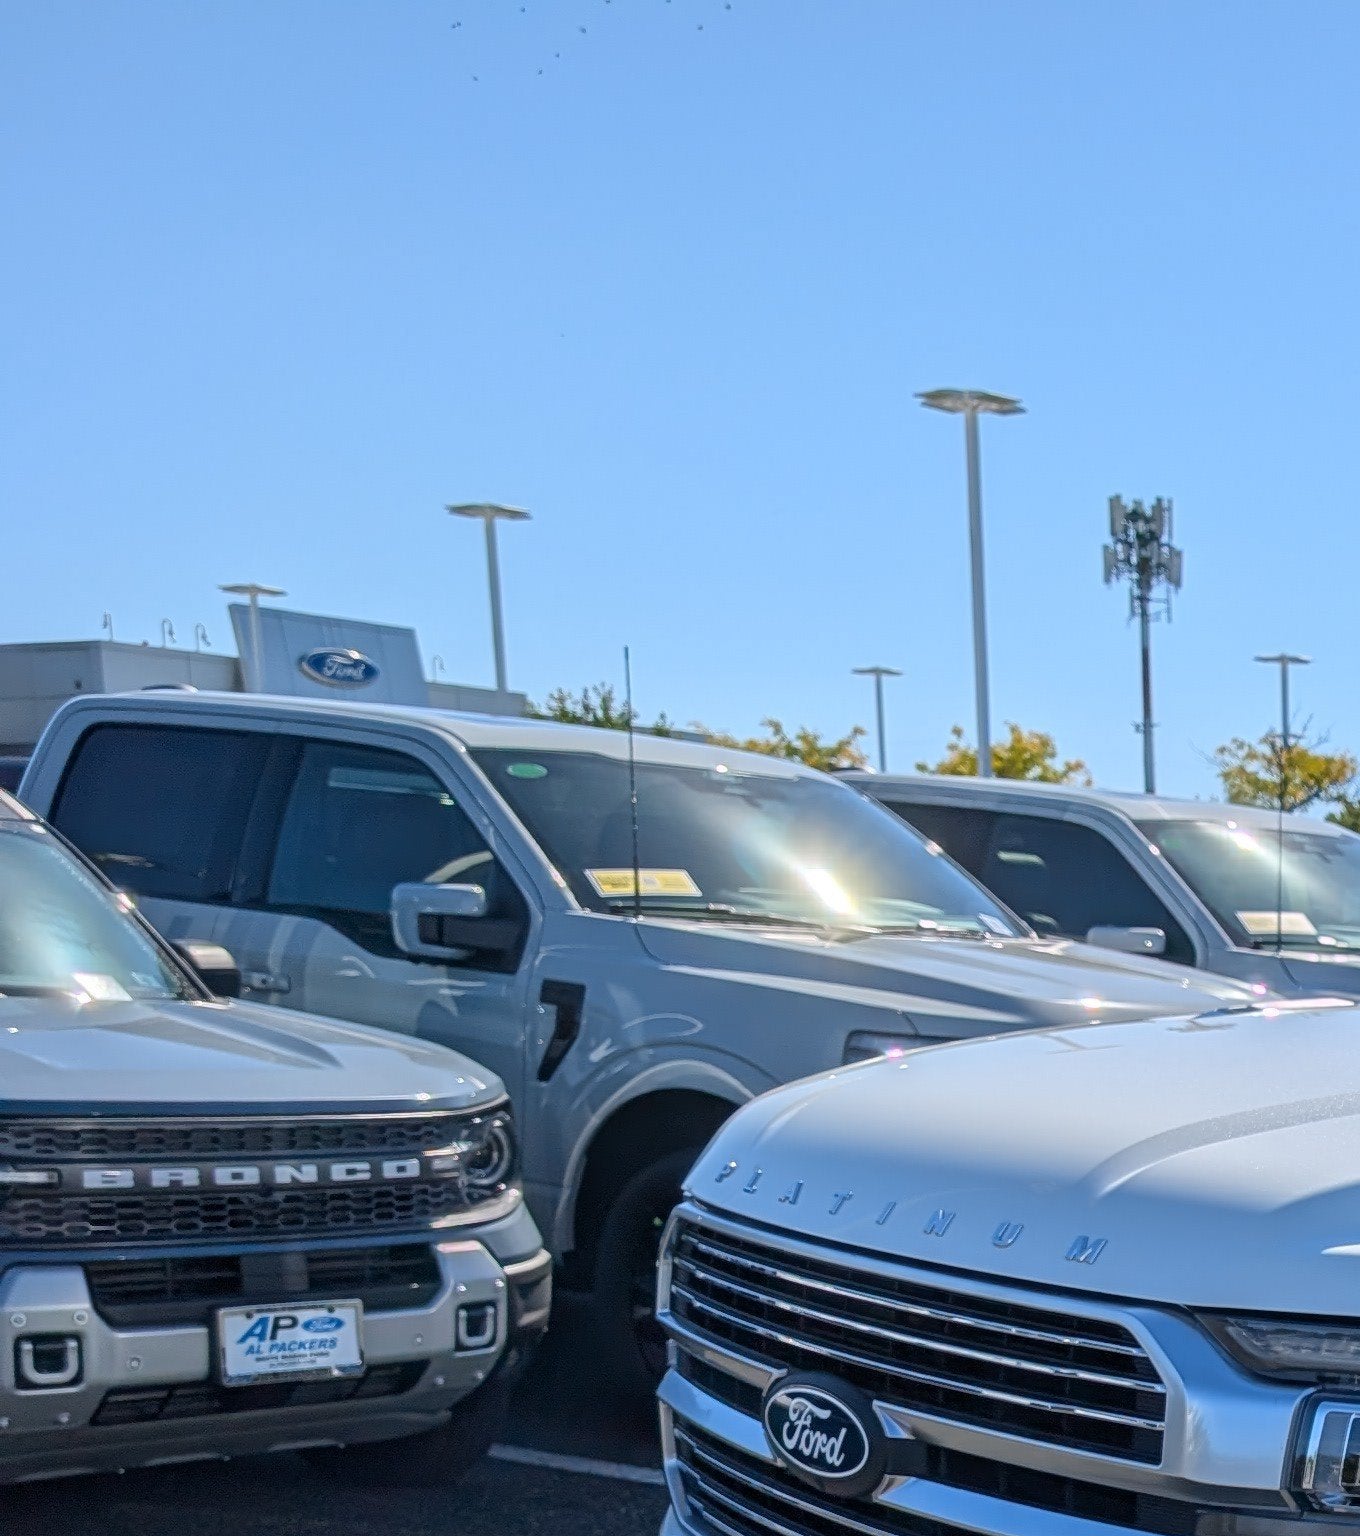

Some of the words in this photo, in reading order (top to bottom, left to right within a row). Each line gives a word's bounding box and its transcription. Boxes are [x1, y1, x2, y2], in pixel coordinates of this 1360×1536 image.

[322, 654, 366, 680] Ford
[82, 1157, 421, 1189] BRONCO
[714, 1160, 1109, 1265] PLATINUM
[237, 1315, 299, 1345] AP
[245, 1344, 264, 1356] AL
[269, 1337, 338, 1354] PACKERS
[780, 1395, 849, 1468] Ford
